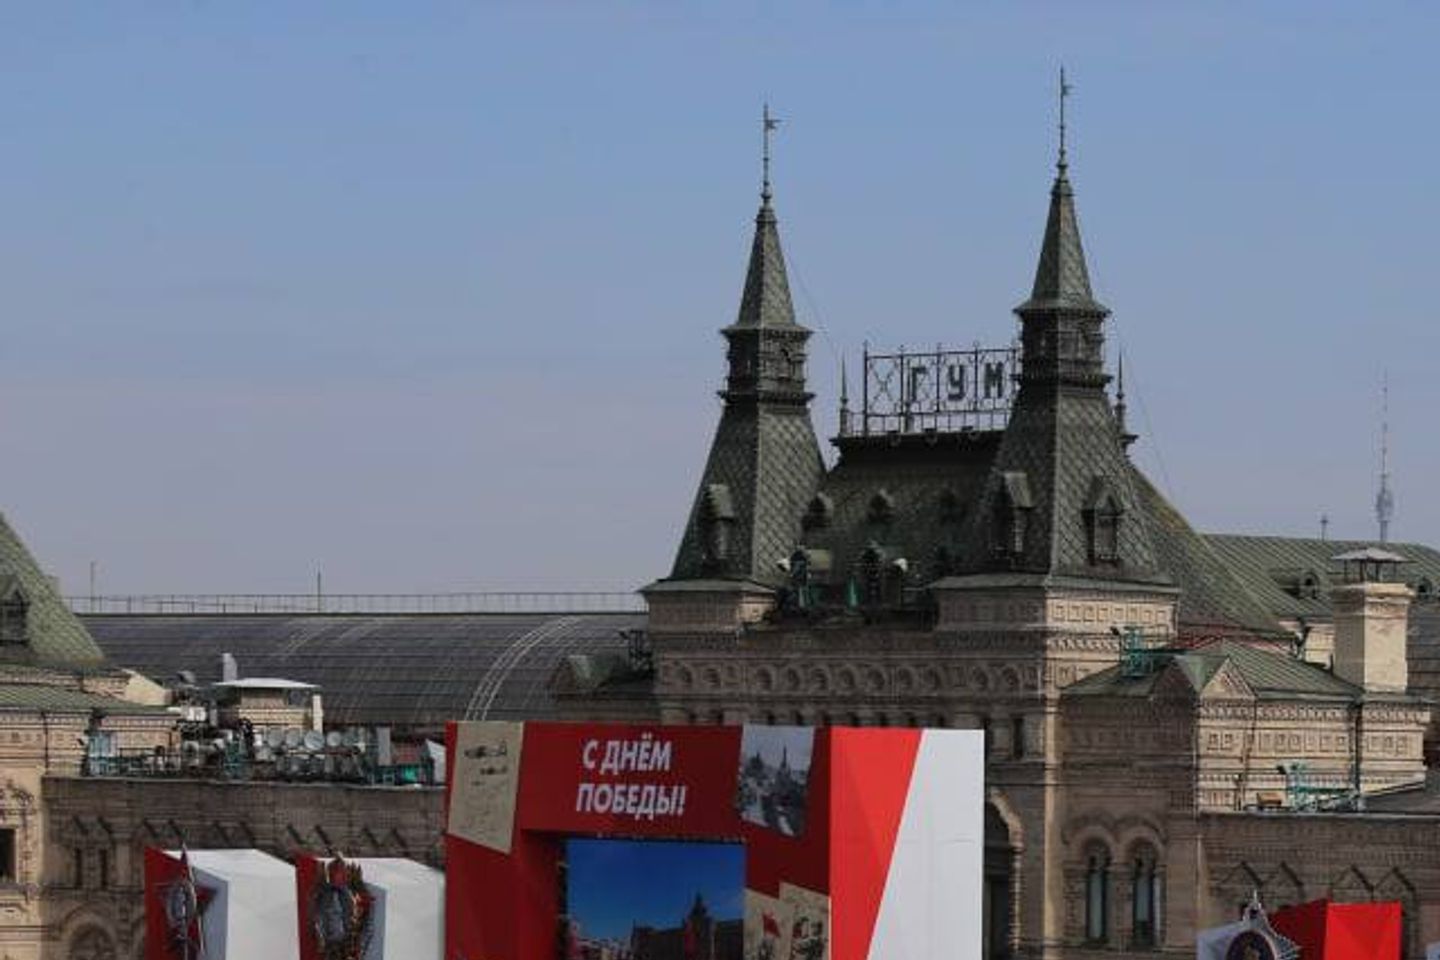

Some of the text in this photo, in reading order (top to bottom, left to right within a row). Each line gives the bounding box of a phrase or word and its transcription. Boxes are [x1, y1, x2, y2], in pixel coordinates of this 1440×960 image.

[911, 361, 1004, 401] ГУМ
[583, 733, 672, 775] С ДНЁМ
[576, 783, 686, 820] ПОБЕДЫ!
